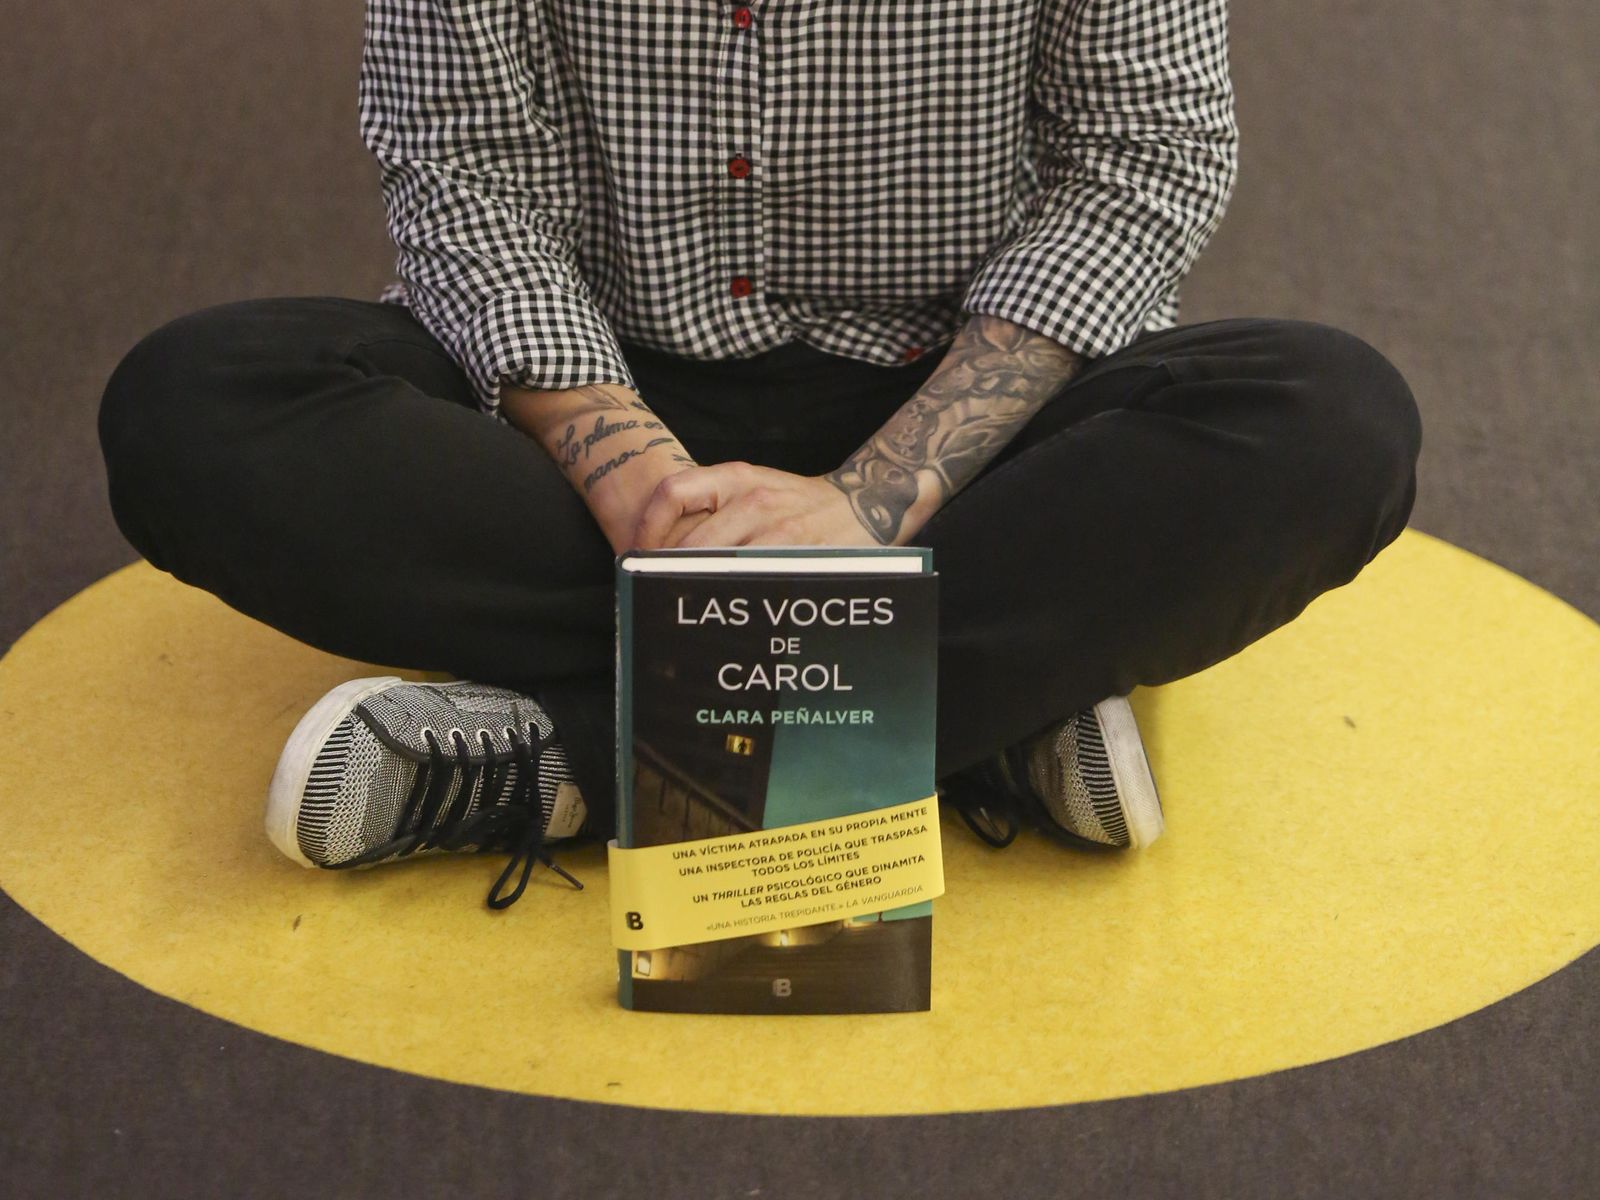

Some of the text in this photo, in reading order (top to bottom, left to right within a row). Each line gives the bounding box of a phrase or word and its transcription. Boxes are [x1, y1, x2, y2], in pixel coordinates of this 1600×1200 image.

[677, 597, 894, 626] LAS VOCES
[770, 637, 800, 654] DE
[717, 663, 853, 691] CAROL
[696, 707, 874, 725] CLARA PEÑALVER
[672, 807, 928, 860] UNA VÍCTIMA ATRAPADA EN SU PROPIA MENTE
[679, 825, 928, 876] UNA INSPECTORA DE POLICÍA QUE TRASPASA
[751, 851, 860, 877] TODOS LOS LÍMITES
[692, 854, 925, 904] UN THRILLER PSICOLÓGICO QUE DINAMITA
[741, 876, 882, 908] LAS REGLAS DEL GÉNERO
[734, 914, 777, 926] HISTORIA
[846, 899, 859, 909] LA
[862, 885, 924, 905] VANGUARDIA
[625, 911, 644, 930] B
[772, 978, 792, 997] B
